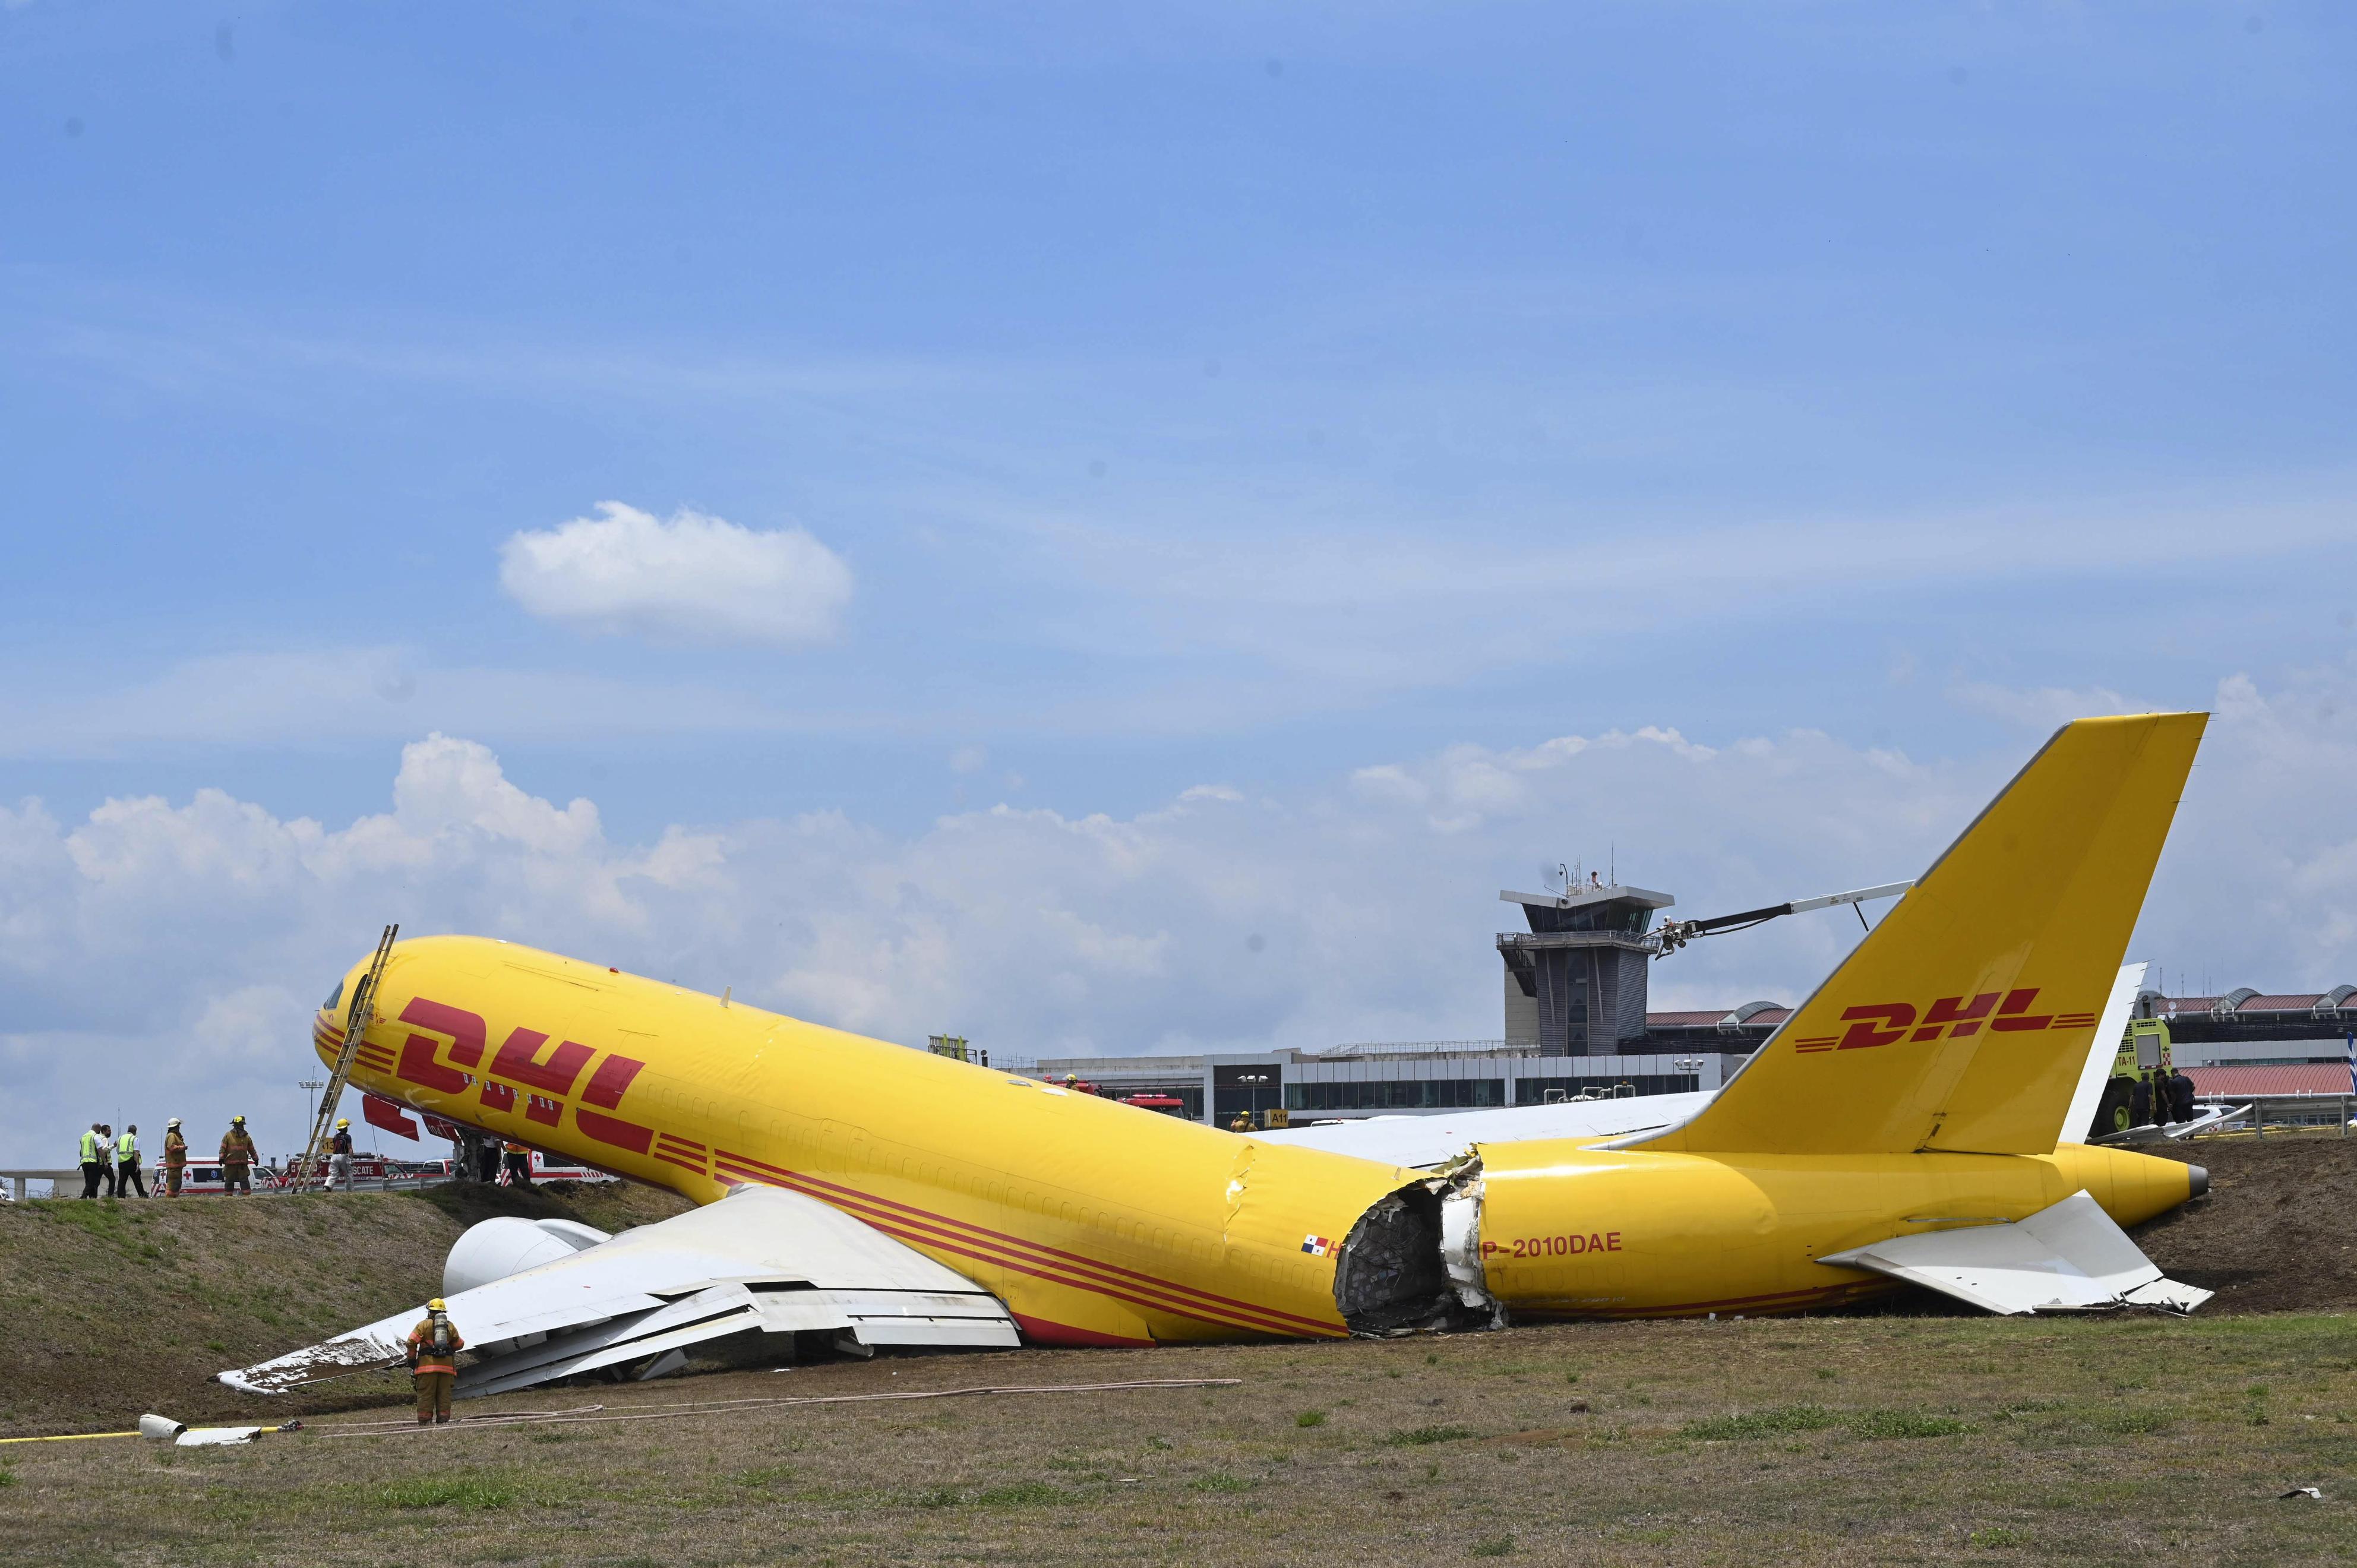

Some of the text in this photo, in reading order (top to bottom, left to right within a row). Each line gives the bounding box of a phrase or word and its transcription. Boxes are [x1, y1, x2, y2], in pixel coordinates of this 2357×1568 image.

[1837, 988, 2054, 1050] DHL
[2118, 1056, 2135, 1066] TA-11
[396, 996, 654, 1155] DHL
[1272, 1113, 1287, 1123] A11
[428, 1124, 443, 1136] 104
[1482, 1232, 1622, 1260] P-2010DAE
